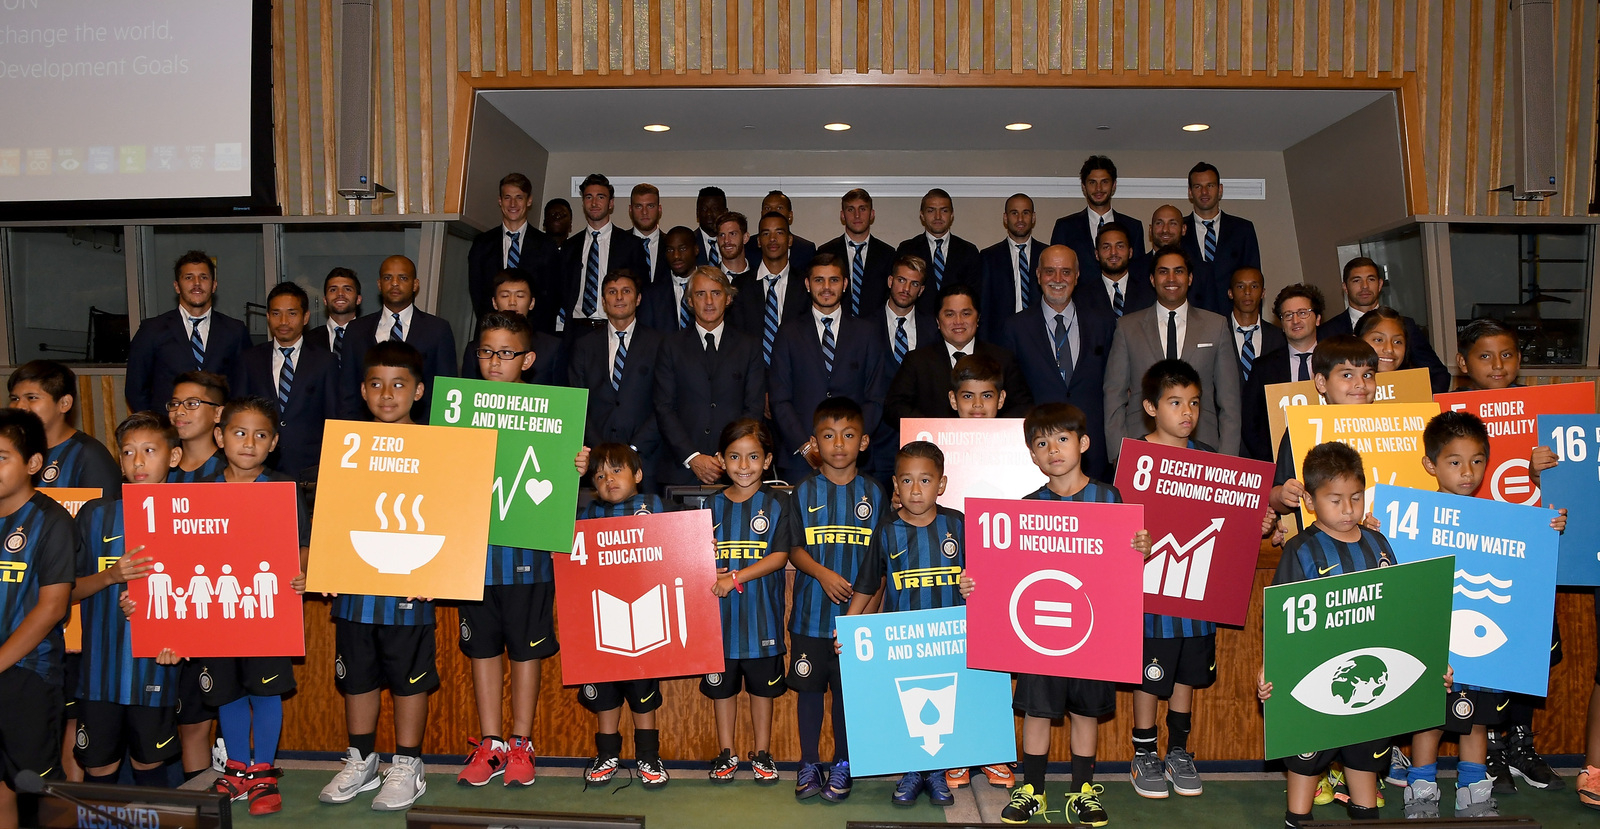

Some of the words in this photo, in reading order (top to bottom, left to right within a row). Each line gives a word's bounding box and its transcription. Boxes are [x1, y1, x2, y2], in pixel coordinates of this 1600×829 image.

[75, 22, 107, 42] the
[113, 19, 174, 41] world.
[132, 54, 189, 75] Goals
[444, 389, 463, 423] 3
[473, 392, 506, 411] GOOD
[506, 394, 549, 414] HEALTH
[1480, 401, 1525, 418] GENDER
[471, 411, 496, 428] AND
[497, 414, 562, 434] WELL-BEING
[1308, 418, 1323, 446] 7
[1333, 417, 1402, 433] AFFORDABLE
[1403, 416, 1425, 431] AND
[340, 432, 361, 469] 2
[371, 436, 404, 452] ZERO
[1376, 436, 1417, 452] ENERGY
[1551, 425, 1587, 462] 16
[369, 456, 420, 474] HUNGER
[1132, 455, 1154, 491] 8
[1160, 458, 1204, 479] DECENT
[1204, 466, 1238, 486] WORK
[1238, 472, 1262, 490] AND
[172, 497, 190, 513] NO
[1155, 478, 1213, 502] ECONOMIC
[1213, 488, 1260, 510] GROWTH
[142, 496, 156, 533] 1
[1019, 514, 1079, 533] REDUCED
[1386, 500, 1419, 540] 14
[1434, 506, 1461, 527] LIFE
[173, 518, 229, 535] POVERTY
[597, 528, 645, 548] QUALITY
[805, 525, 873, 547] PIRELLI
[979, 512, 1012, 550] 10
[570, 531, 589, 566] 4
[1019, 534, 1104, 555] INEQUALITIES
[1431, 528, 1482, 551] BELOW
[1481, 536, 1526, 559] WATER
[598, 546, 663, 566] EDUCATION
[1325, 583, 1384, 608] CLIMATE
[1282, 594, 1317, 634] 13
[1325, 605, 1376, 629] ACTION
[885, 625, 925, 641] CLEAN
[927, 619, 967, 637] WATER
[854, 627, 874, 662] 6
[887, 645, 913, 661] AND
[77, 804, 160, 829] RESERVED
